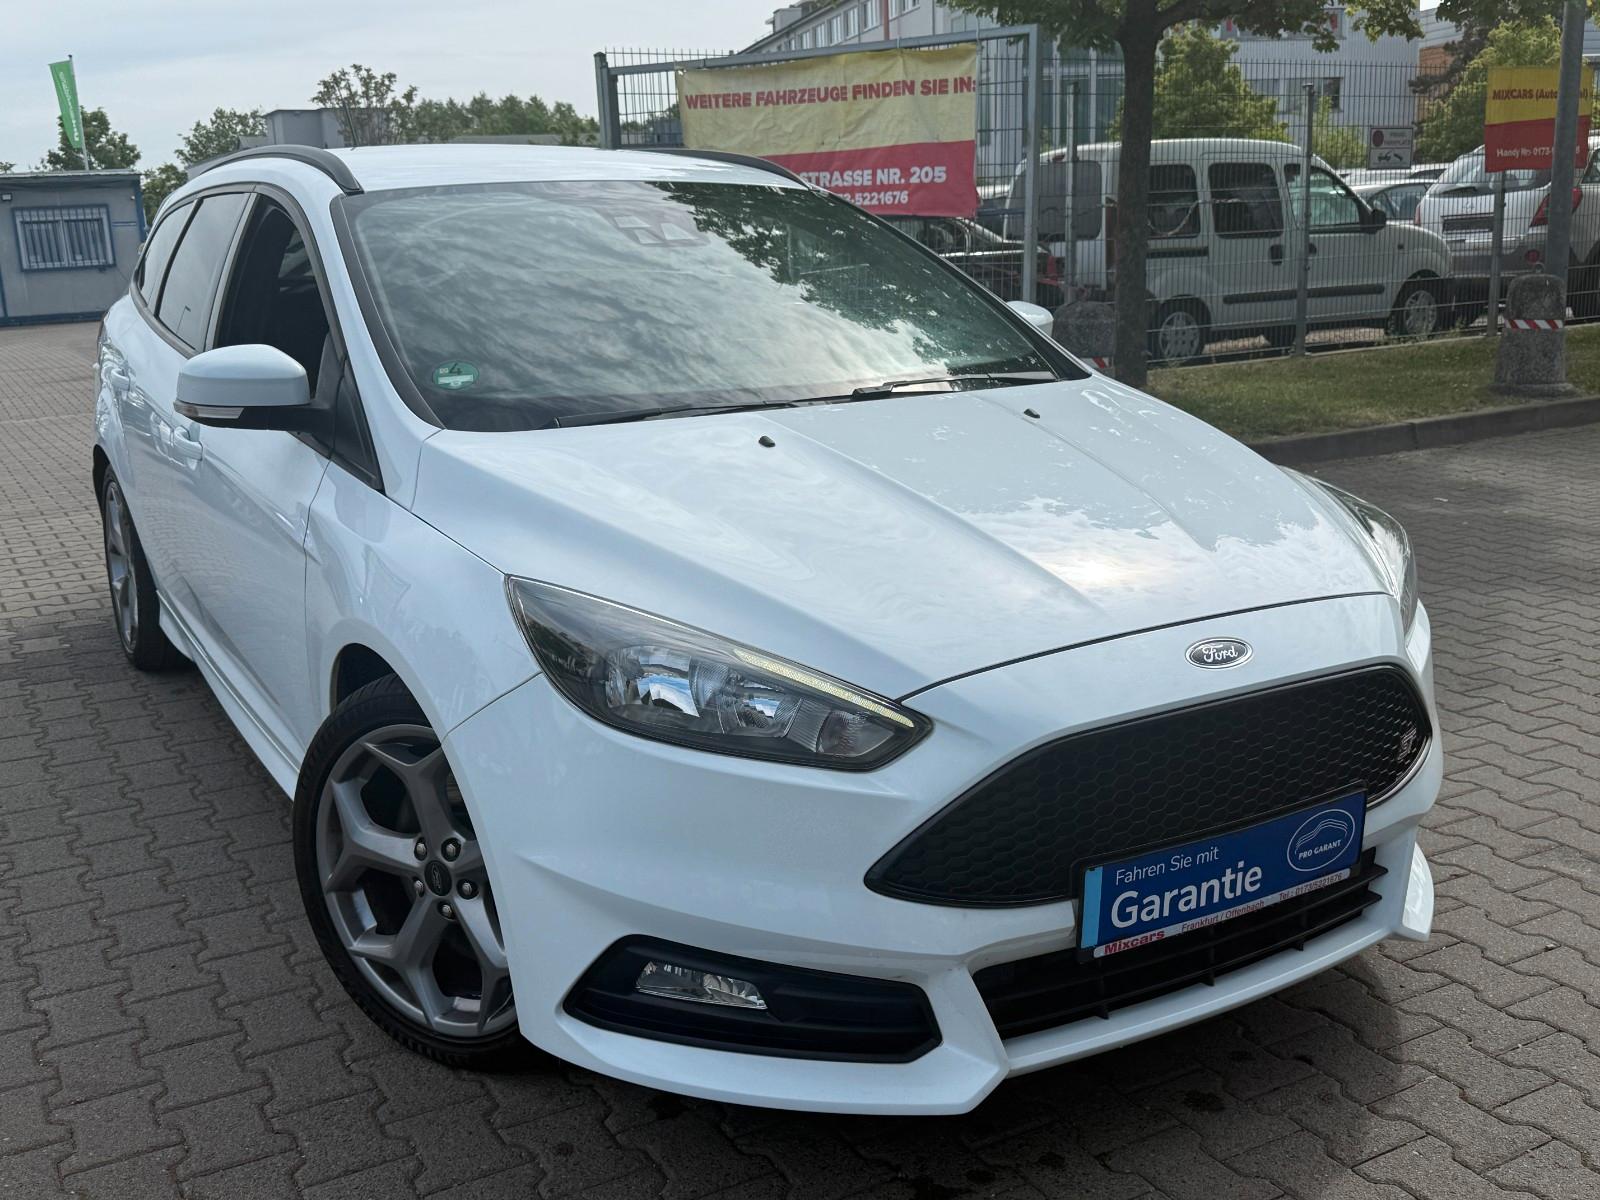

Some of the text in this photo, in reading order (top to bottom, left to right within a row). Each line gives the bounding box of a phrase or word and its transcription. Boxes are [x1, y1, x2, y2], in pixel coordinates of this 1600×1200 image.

[685, 76, 976, 110] WEITERE FAHRZEUGE FINDEN SIE IN:
[1492, 89, 1534, 100] MIXCARS
[1496, 147, 1520, 159] Handy
[876, 168, 905, 185] NR.
[909, 166, 947, 184] 205
[1202, 645, 1239, 662] Ford
[1299, 839, 1342, 860] PRO GARANT
[1115, 846, 1219, 886] Fahren Sie mit
[1111, 860, 1263, 929] Garantie
[1103, 930, 1165, 955] Mixcars
[1181, 910, 1219, 934] Frankfurt
[1225, 900, 1265, 920] Offenbach
